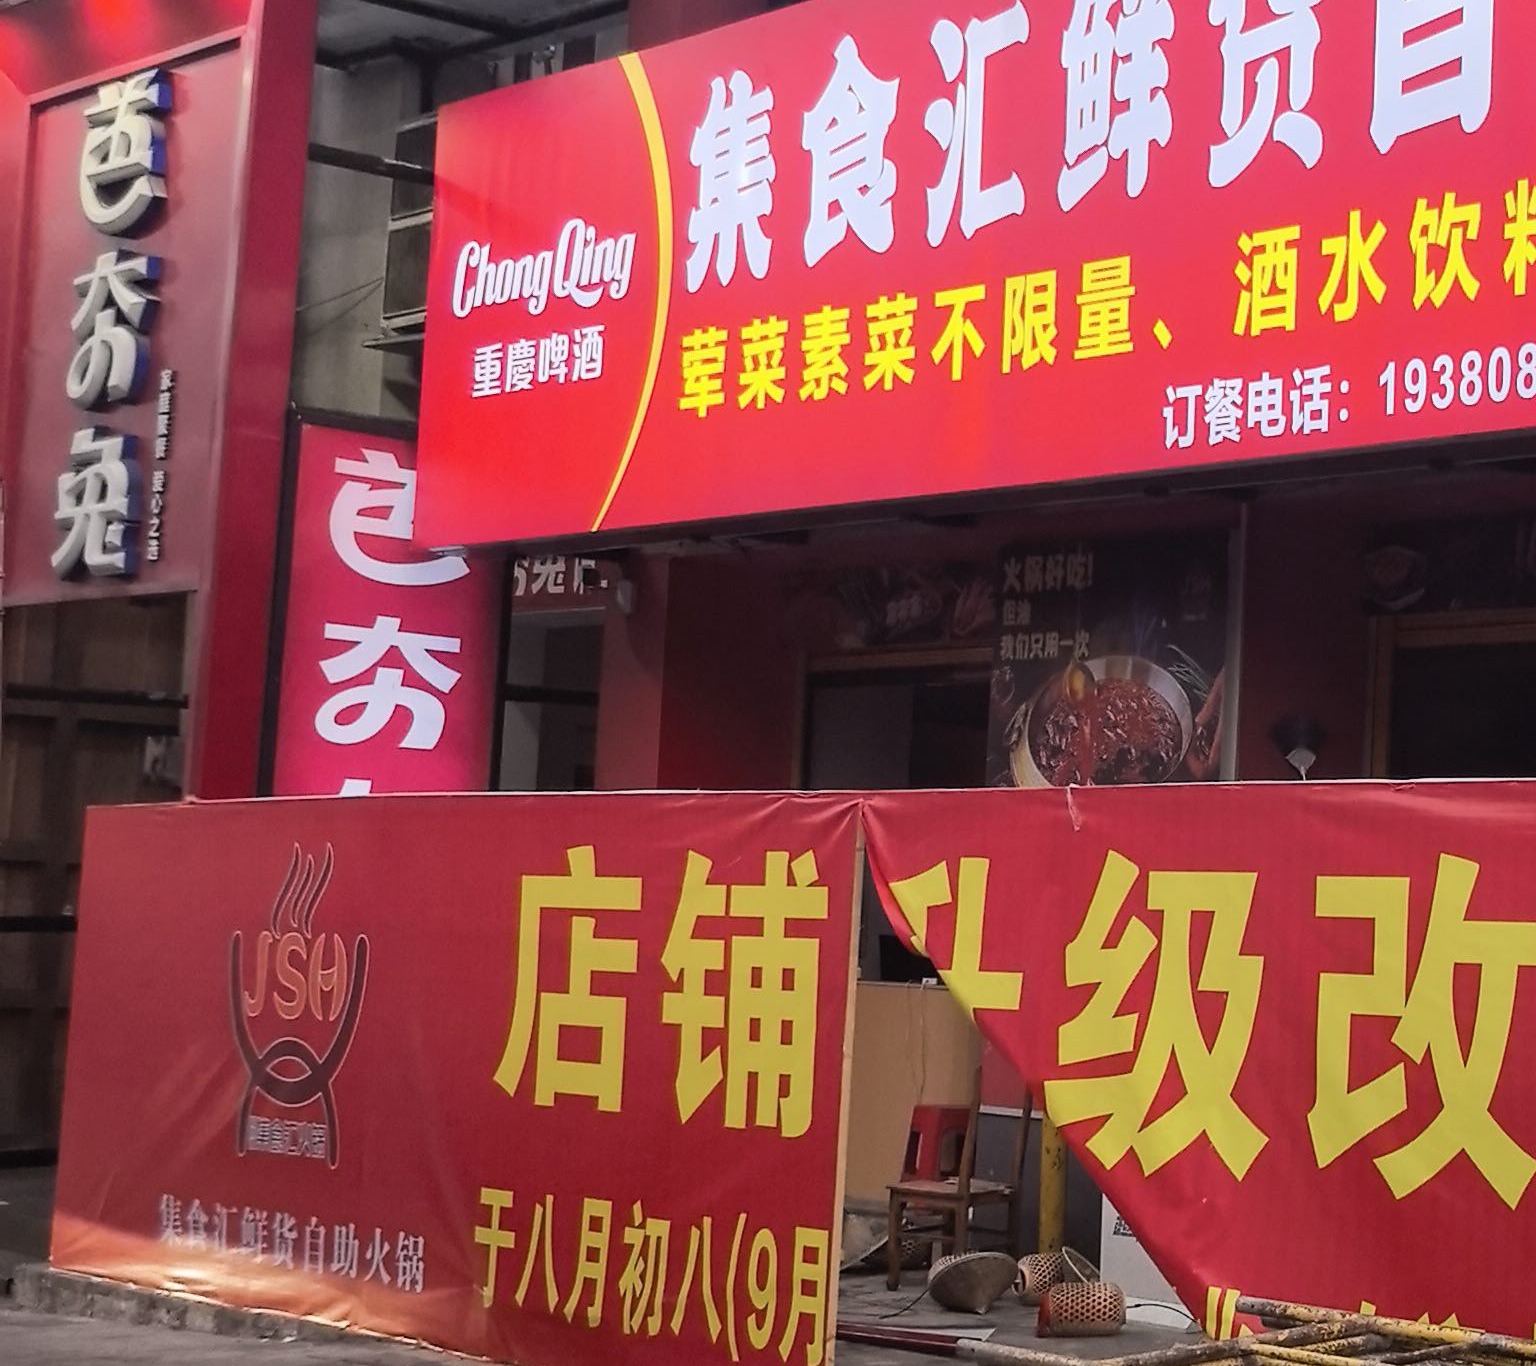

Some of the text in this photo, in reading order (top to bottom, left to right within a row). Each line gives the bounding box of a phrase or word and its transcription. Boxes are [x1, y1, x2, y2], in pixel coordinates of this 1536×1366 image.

[471, 325, 606, 399] 重慶啤酒
[245, 931, 347, 1021] JSH
[158, 1193, 424, 1293] 集食汇鲜货自助火锅
